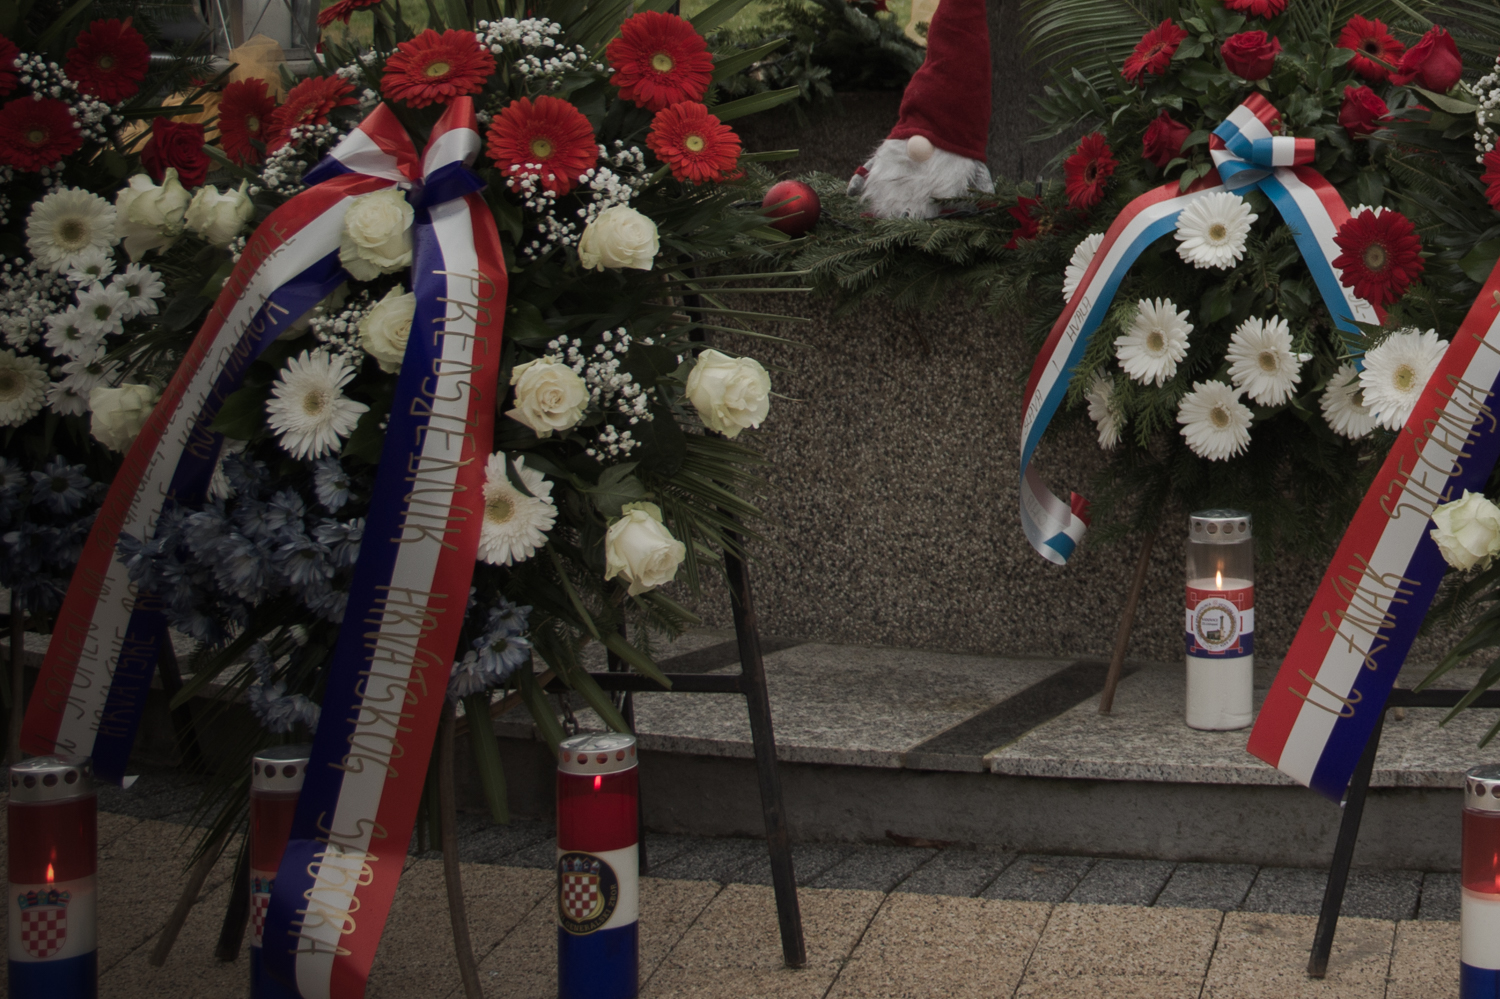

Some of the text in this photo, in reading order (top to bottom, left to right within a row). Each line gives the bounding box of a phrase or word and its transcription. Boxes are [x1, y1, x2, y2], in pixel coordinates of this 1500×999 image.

[43, 607, 99, 721] SPOMEN
[81, 567, 116, 603] NA
[327, 584, 449, 779] HRVATSKOG
[1319, 552, 1422, 672] ZNAK
[1288, 668, 1362, 718] U
[287, 810, 388, 957] SABORA
